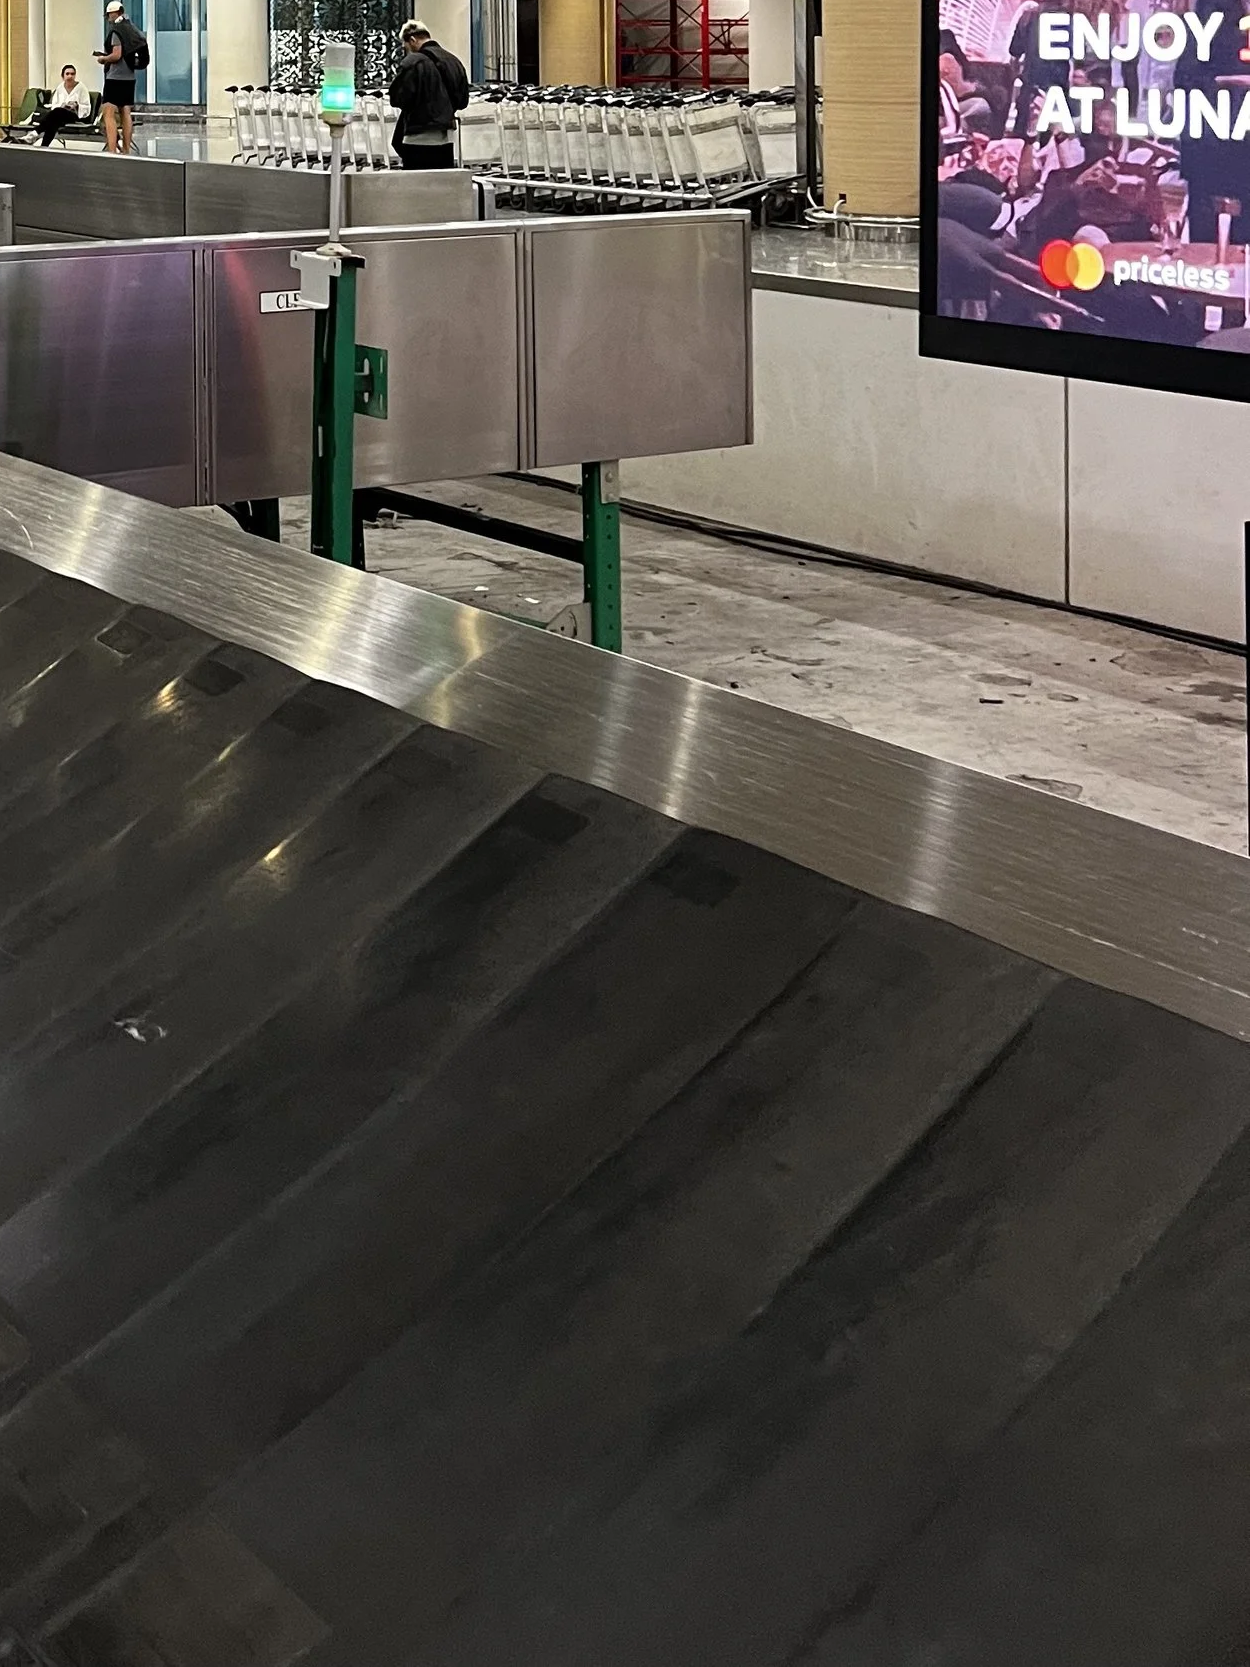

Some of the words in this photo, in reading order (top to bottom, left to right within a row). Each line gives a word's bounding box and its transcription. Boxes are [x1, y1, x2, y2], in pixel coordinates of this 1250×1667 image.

[1038, 12, 1224, 62] ENJOY
[1036, 86, 1104, 134] AT
[1113, 255, 1230, 291] priceless
